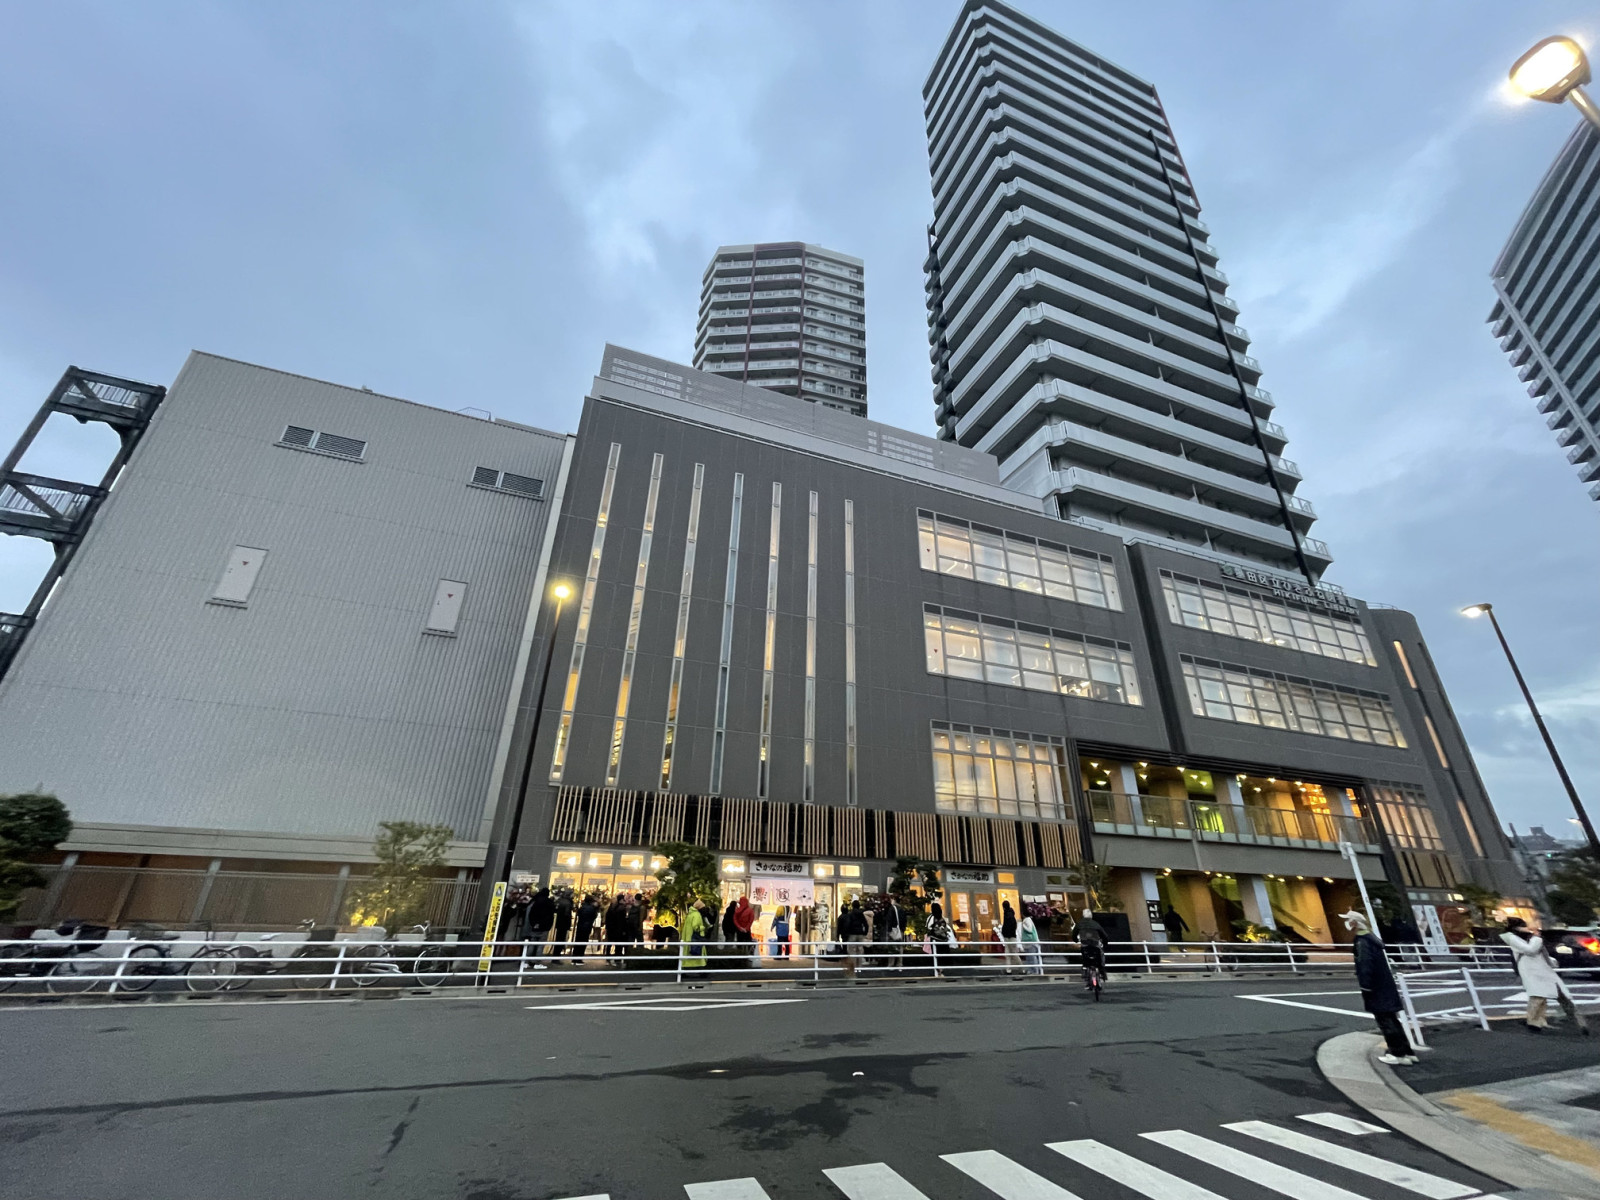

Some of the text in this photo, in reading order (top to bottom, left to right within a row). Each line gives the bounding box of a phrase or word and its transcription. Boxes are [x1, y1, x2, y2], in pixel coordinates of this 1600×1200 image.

[1273, 588, 1360, 615] HIKIFUNE LIBRARY
[755, 861, 803, 873] さかなの福助
